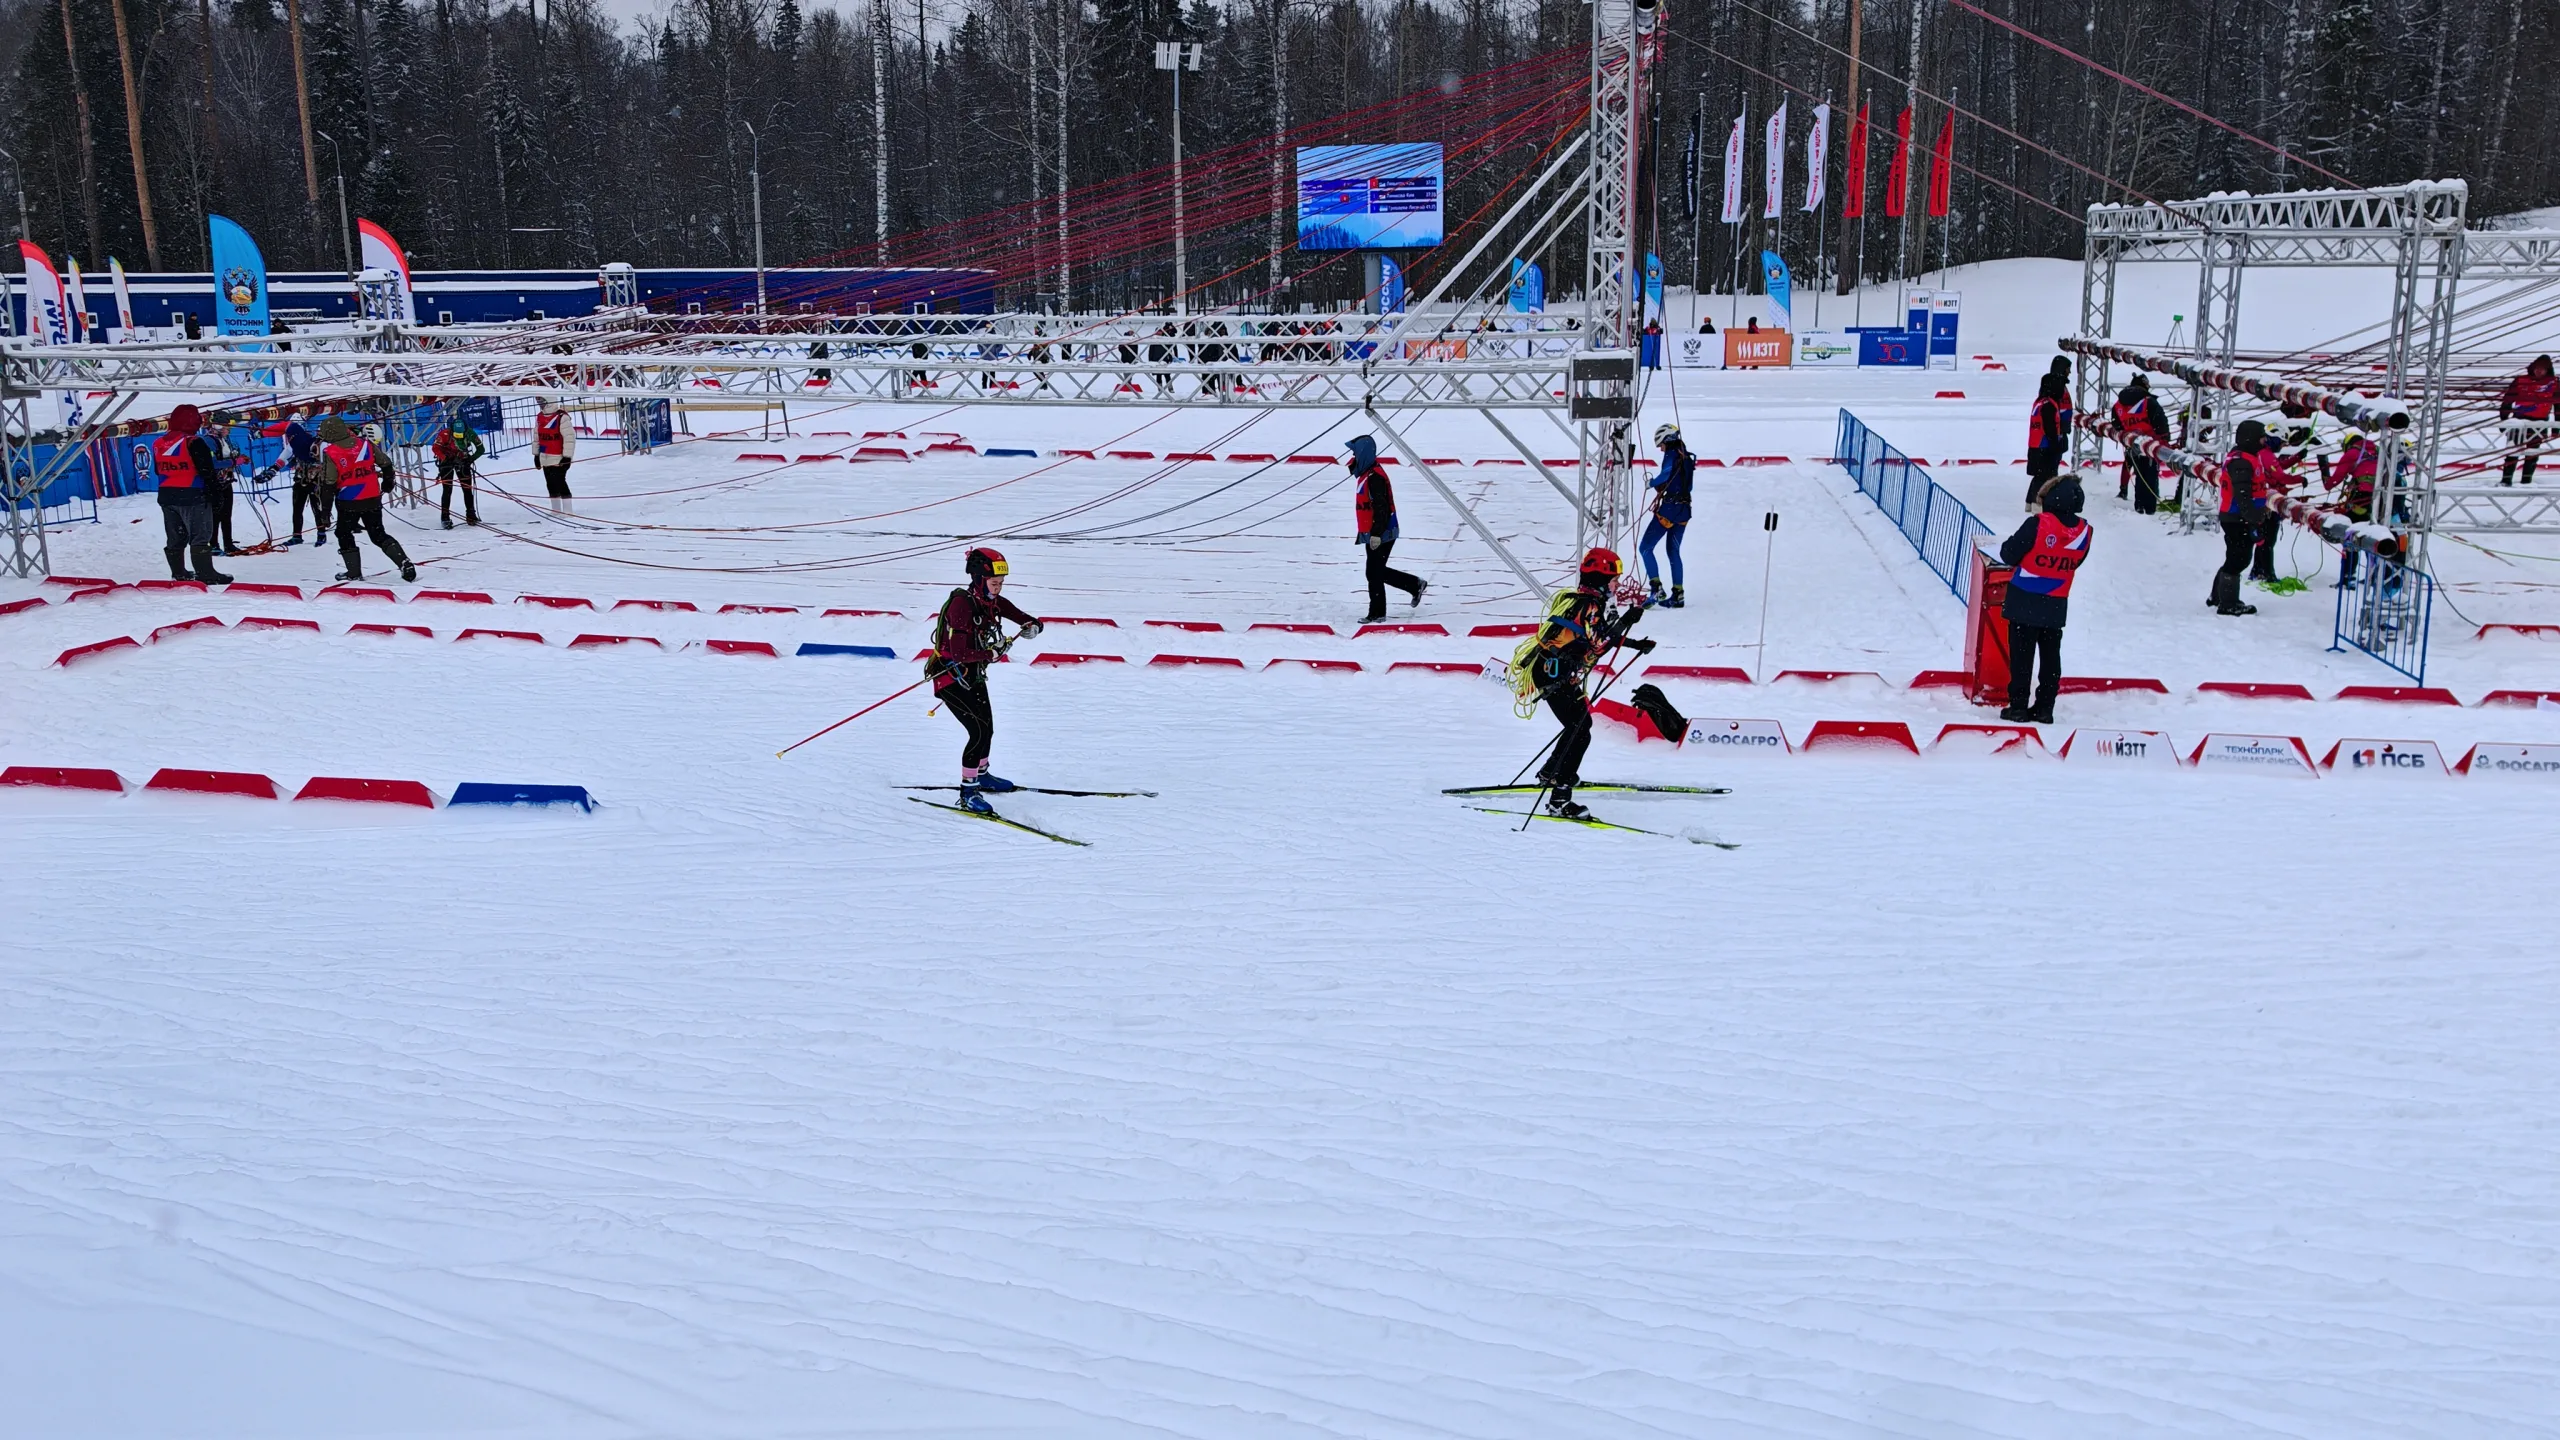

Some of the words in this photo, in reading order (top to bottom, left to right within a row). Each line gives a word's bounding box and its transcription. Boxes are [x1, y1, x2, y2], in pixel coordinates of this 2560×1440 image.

[1753, 342, 1780, 357] ИЗТТ
[2035, 554, 2080, 573] СУДЬ
[1708, 734, 1778, 747] ФОСАГРО
[2115, 741, 2147, 758] ИЗТТ
[2225, 745, 2285, 757] ТЕХНОПАРК
[2381, 752, 2425, 769] ПСБ
